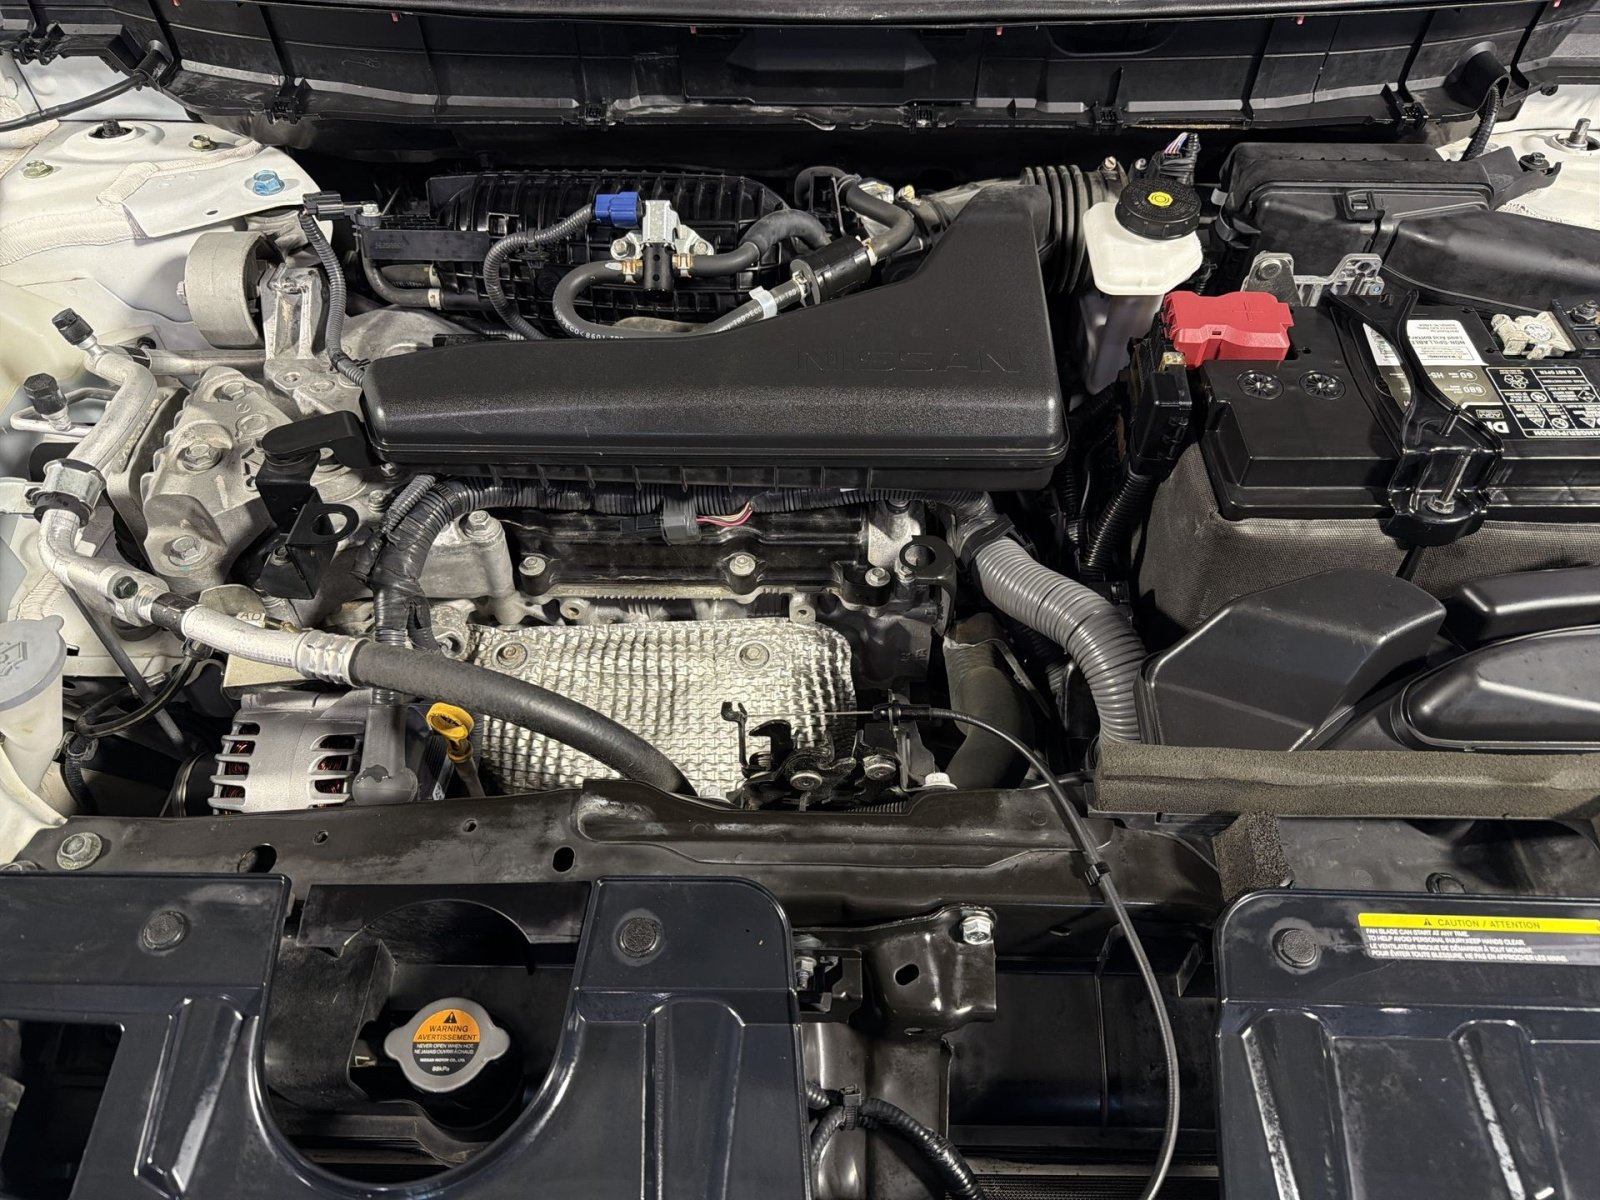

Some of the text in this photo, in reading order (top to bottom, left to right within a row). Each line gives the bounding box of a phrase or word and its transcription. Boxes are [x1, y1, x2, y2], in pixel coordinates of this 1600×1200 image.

[795, 350, 1020, 373] NISSAN
[1483, 421, 1509, 433] DI
[1438, 919, 1481, 928] CAUTION
[1490, 920, 1540, 929] ATTENTION
